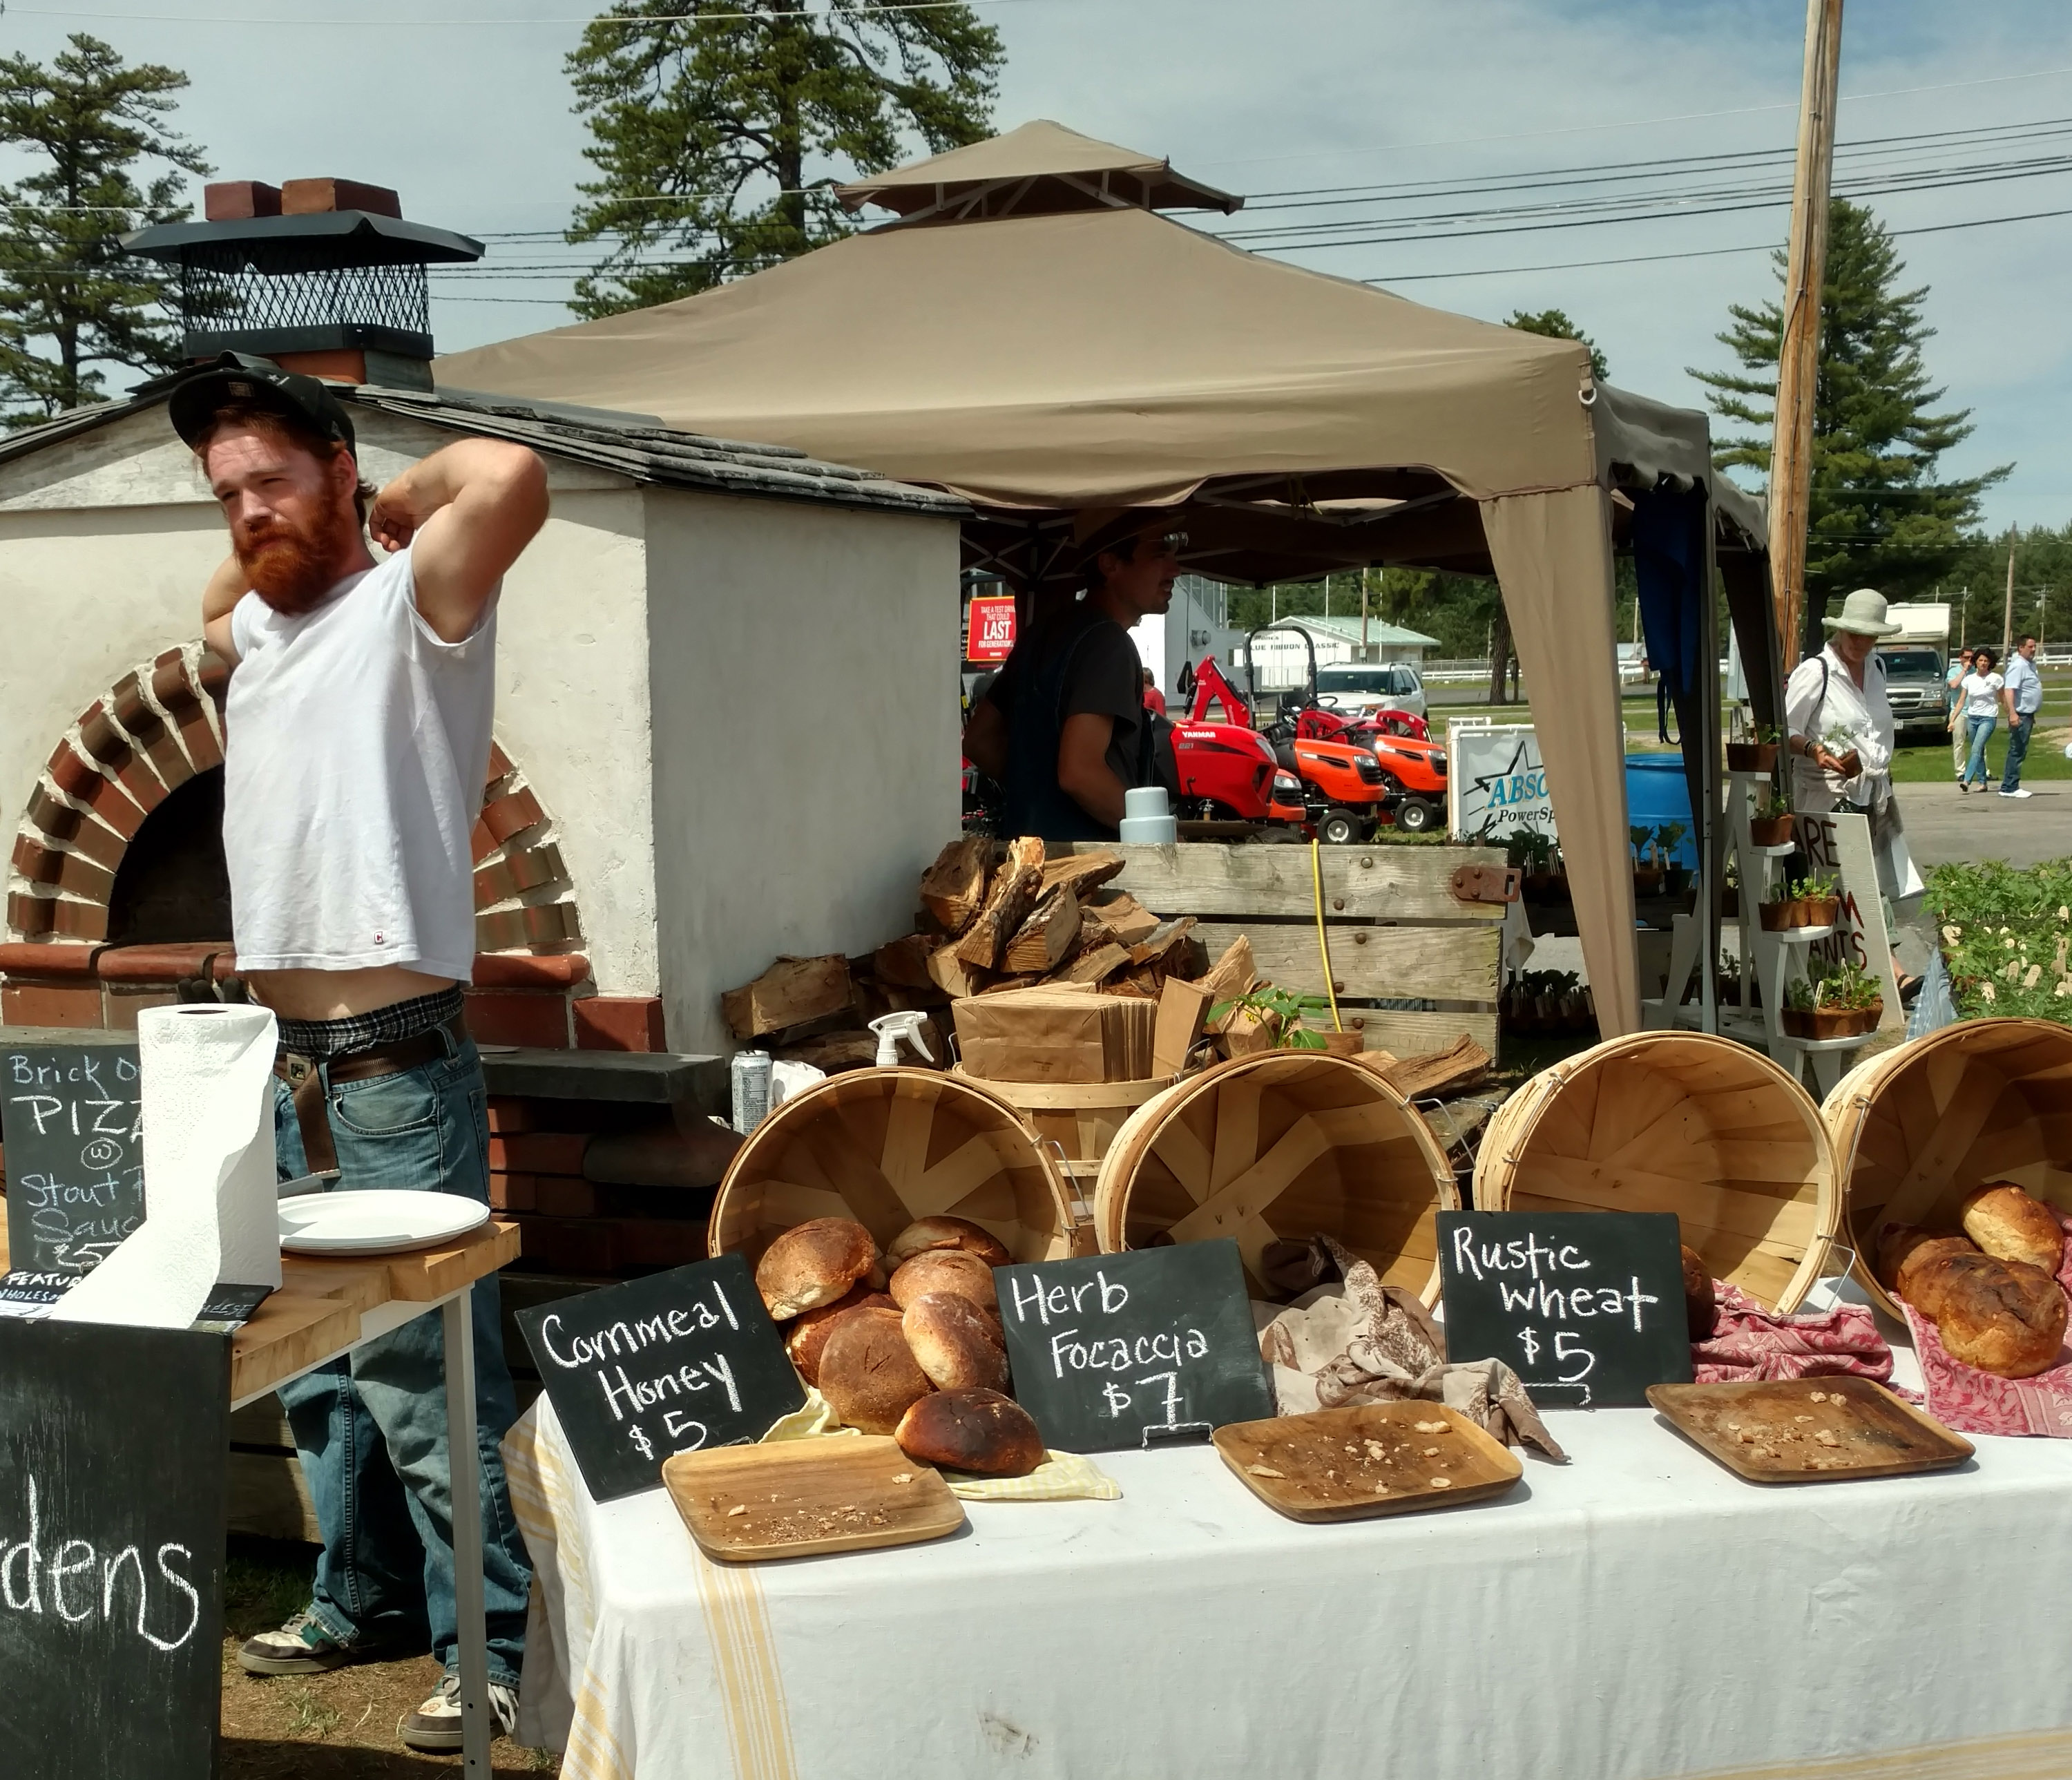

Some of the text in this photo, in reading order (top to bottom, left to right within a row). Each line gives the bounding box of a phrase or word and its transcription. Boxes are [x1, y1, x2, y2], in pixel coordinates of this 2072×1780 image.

[984, 621, 1011, 640] LAST
[9, 1054, 109, 1100] Brick
[21, 1172, 119, 1207] Stout
[1453, 1226, 1591, 1281] Rustic
[541, 1280, 740, 1369] Cornmeal
[1011, 1270, 1129, 1326] Herb
[1050, 1321, 1209, 1379] Focaccia
[597, 1352, 742, 1422] Honey
[0, 1473, 199, 1651] dens
